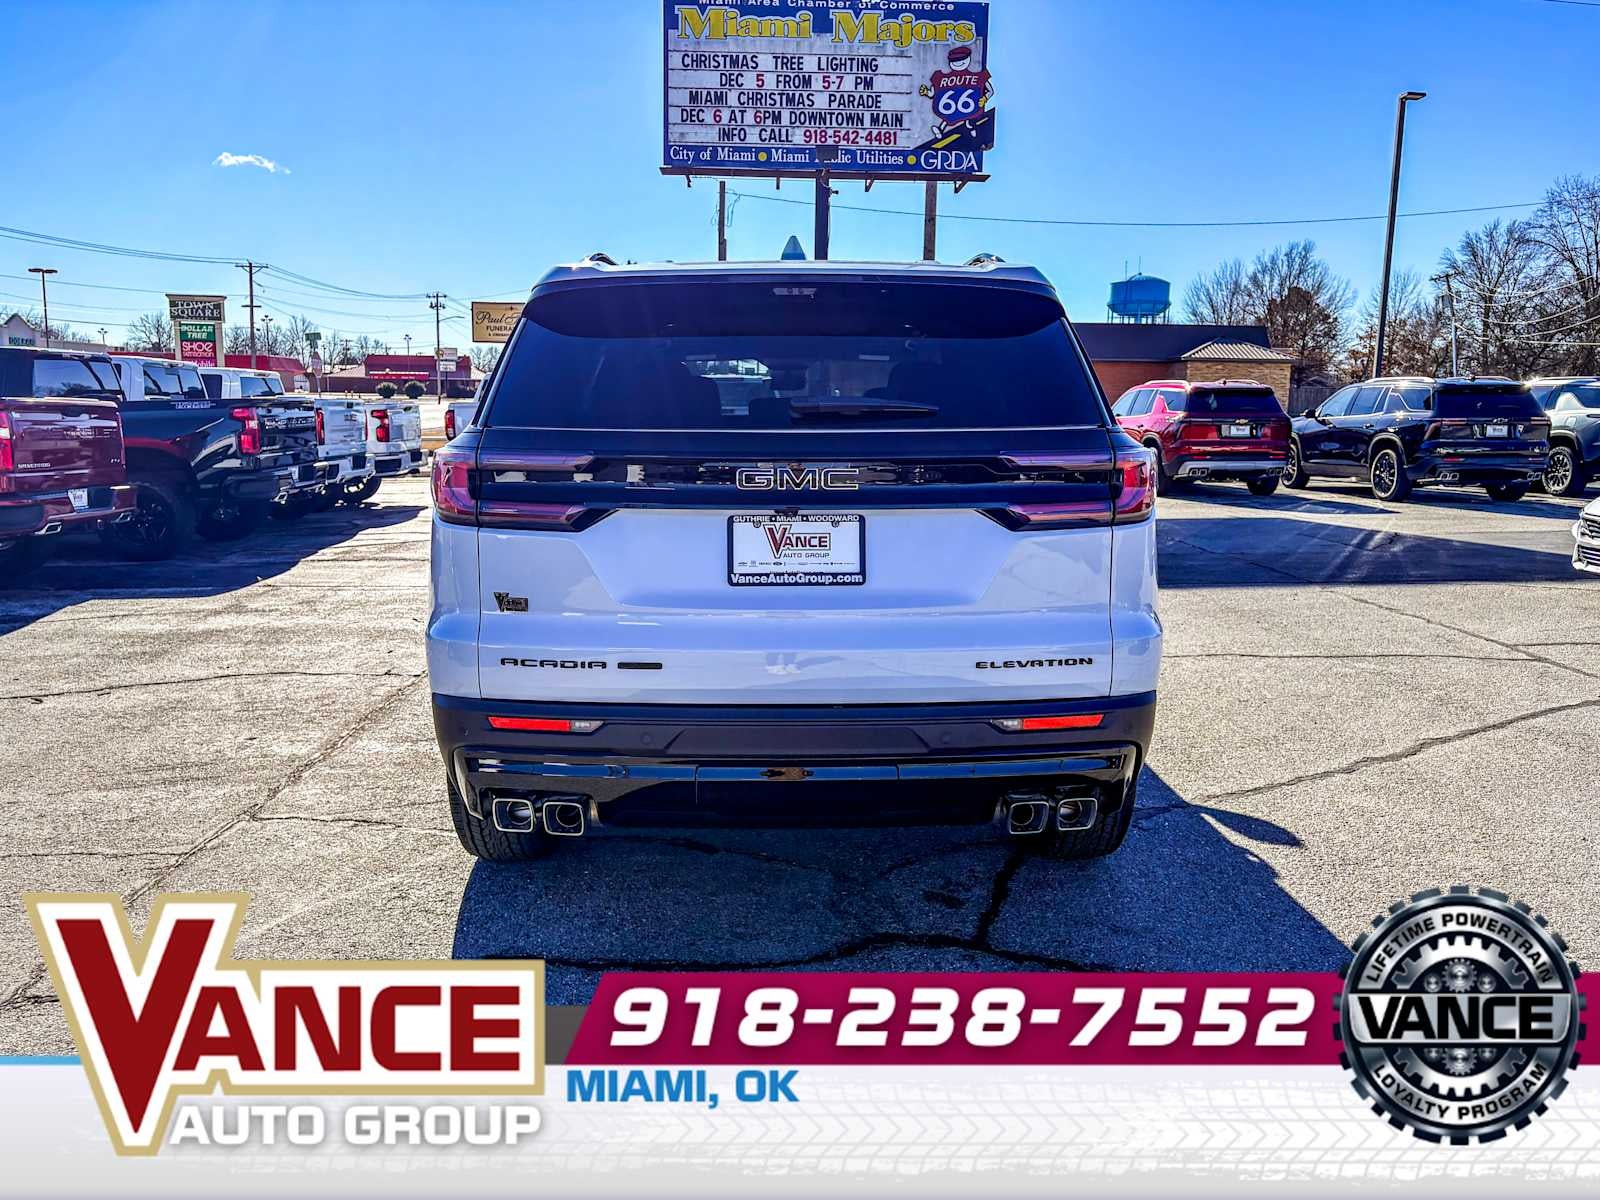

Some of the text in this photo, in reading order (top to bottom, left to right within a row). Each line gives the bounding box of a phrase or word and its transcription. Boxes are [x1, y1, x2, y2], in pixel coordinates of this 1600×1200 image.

[788, 0, 851, 8] Chamber
[858, 0, 871, 8] of
[879, 1, 955, 10] Commerce
[676, 7, 976, 48] Miami Majors
[681, 53, 879, 72] CHRISTMAS TREE LIGHTING
[719, 73, 874, 91] DEC 5 FROM 5-7 PM
[939, 75, 979, 88] ROUTE
[688, 90, 882, 109] MIAMI CHRISTMAS PARADE
[938, 89, 976, 115] 66
[680, 108, 904, 128] DEC 6 AT 6PM DOWNTOWN MAIN
[718, 128, 898, 146] INFO CALL 918-542-4481
[669, 146, 696, 163] City
[699, 147, 712, 161] of
[716, 147, 756, 162] Miami
[770, 148, 810, 163] Miami
[856, 150, 904, 165] Utilities
[920, 151, 979, 171] GRDA
[171, 308, 220, 317] SQUARE
[175, 301, 214, 310] TOWN
[735, 468, 860, 491] GMC
[732, 515, 860, 523] GUTHRIE MIAMI WOODWARD
[765, 525, 829, 558] VANCE
[730, 573, 863, 586] VanceAutoGroup.com
[500, 657, 608, 670] ACADIA
[975, 657, 1094, 670] ELEVATION
